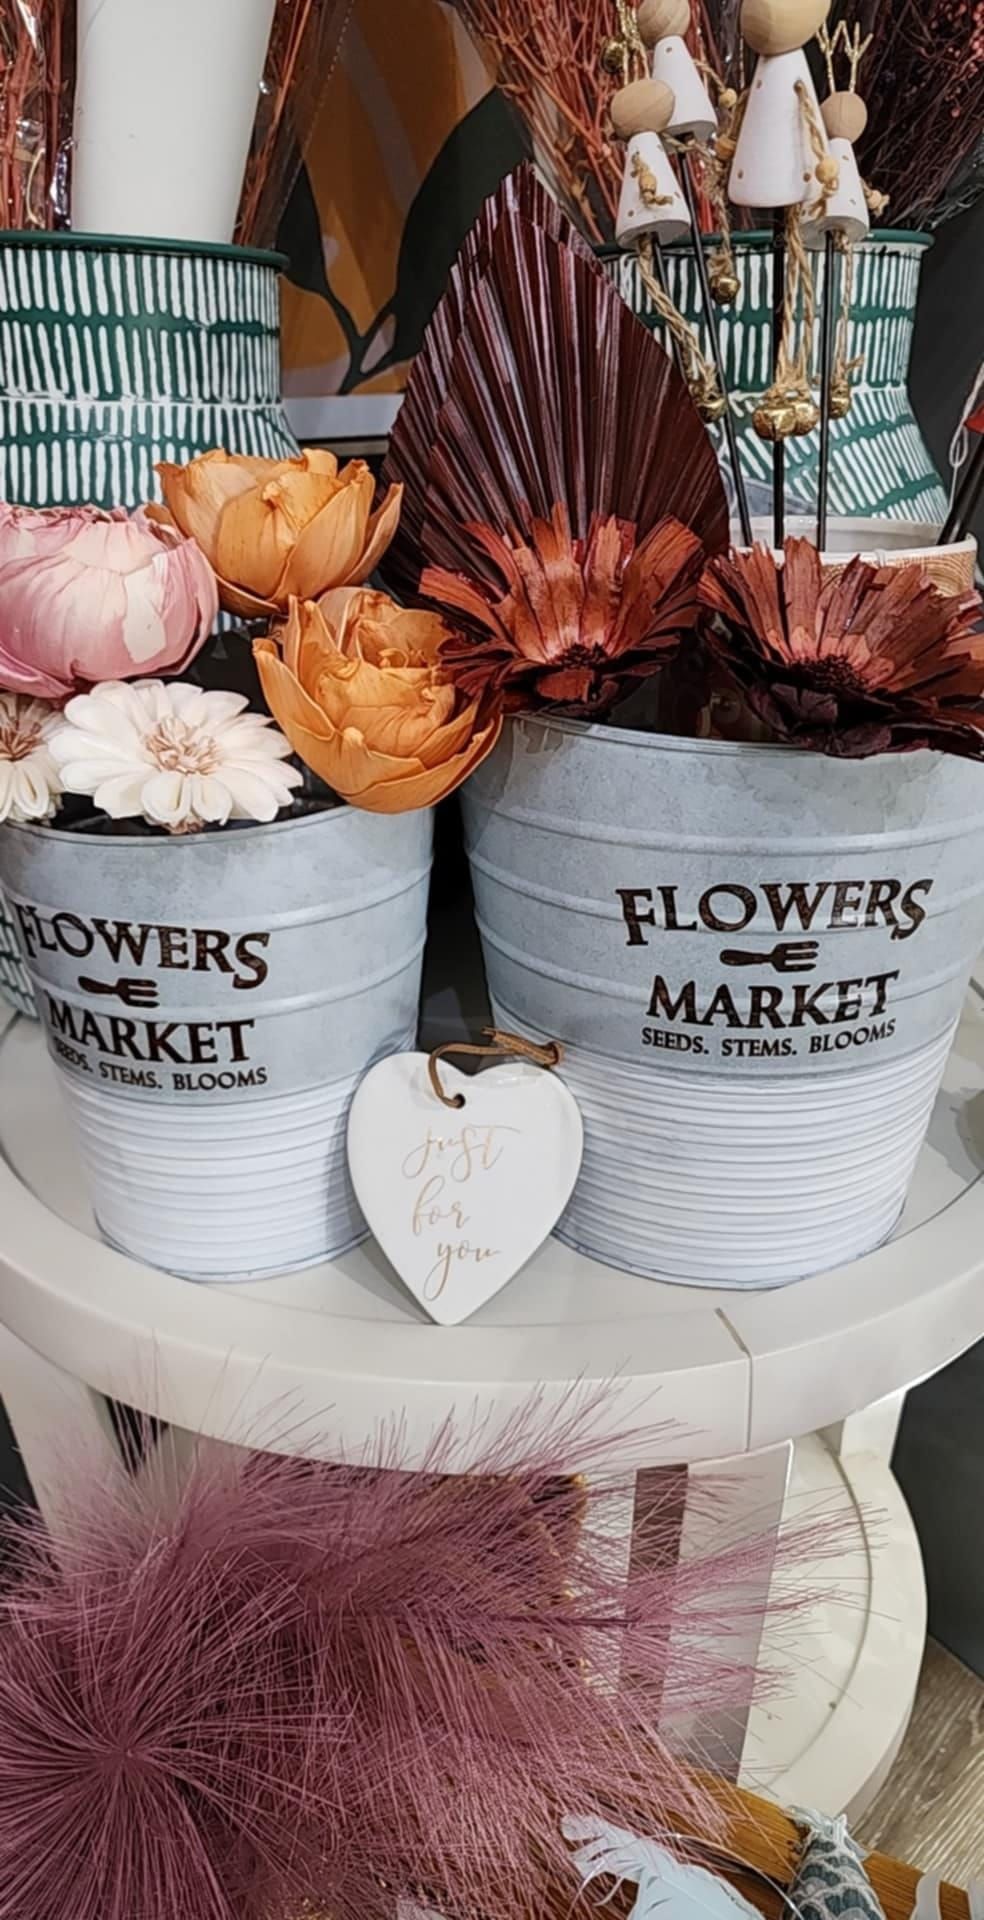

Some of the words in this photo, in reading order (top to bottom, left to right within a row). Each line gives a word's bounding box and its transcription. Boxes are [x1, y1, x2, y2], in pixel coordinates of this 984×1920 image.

[615, 879, 934, 946] FLOWERS
[14, 902, 271, 990] FLOWERS
[44, 989, 255, 1064] MARKET
[646, 970, 900, 1029] MARKET
[641, 1027, 709, 1055] SEEDS.
[721, 1037, 797, 1057] STEMS.
[808, 1018, 897, 1054] BLOOMS
[99, 1061, 163, 1089] STEMS.
[172, 1066, 268, 1091] BLOOMS
[401, 1123, 521, 1183] just
[412, 1174, 471, 1238] for
[423, 1239, 501, 1302] you
